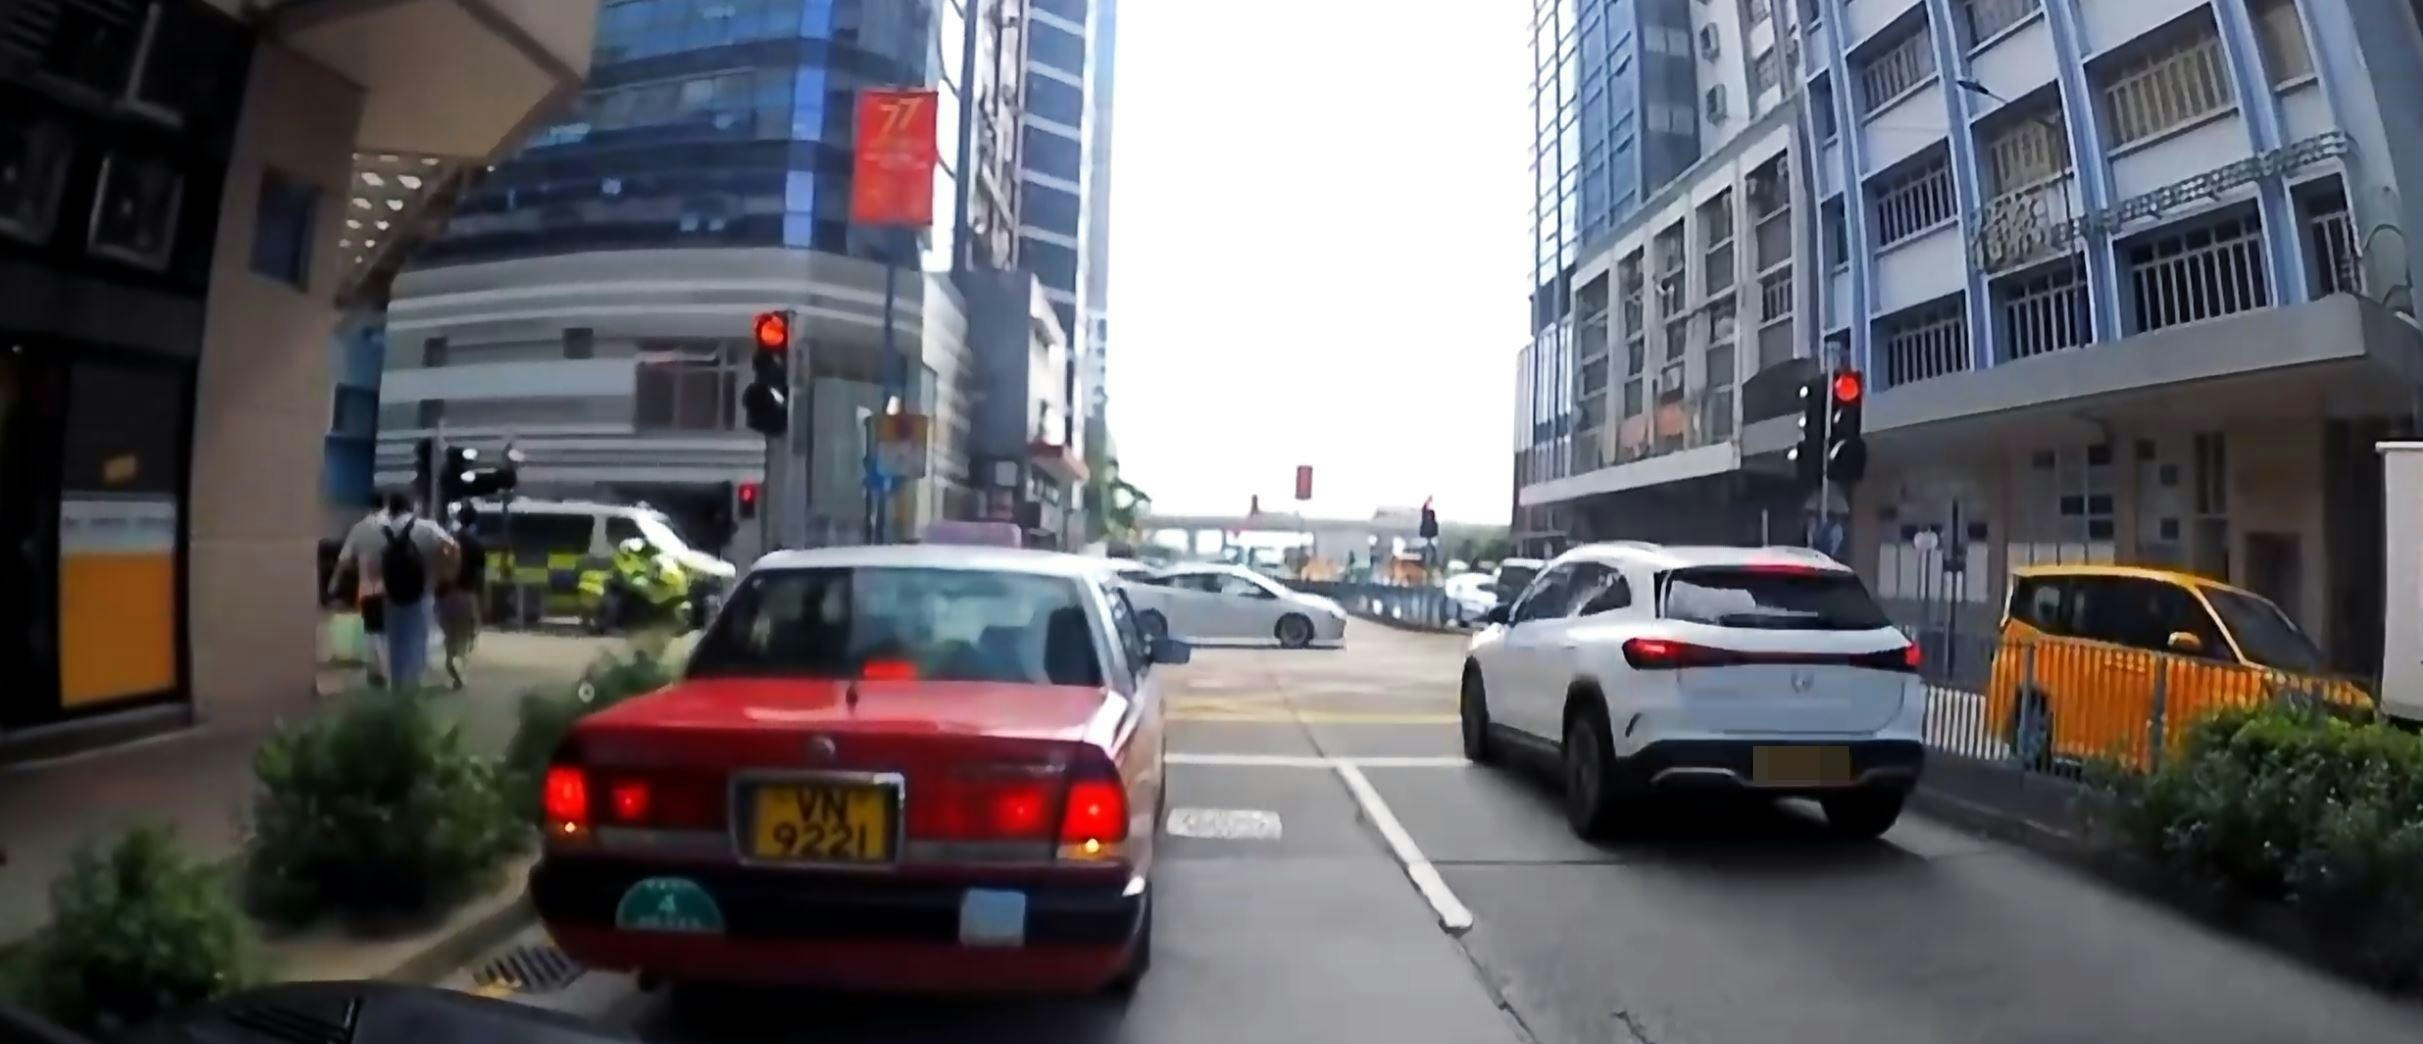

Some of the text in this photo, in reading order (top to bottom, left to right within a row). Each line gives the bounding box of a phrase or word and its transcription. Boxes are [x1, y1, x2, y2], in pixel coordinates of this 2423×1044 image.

[870, 97, 923, 147] 77
[796, 785, 848, 824] VN
[773, 821, 867, 856] 9221
